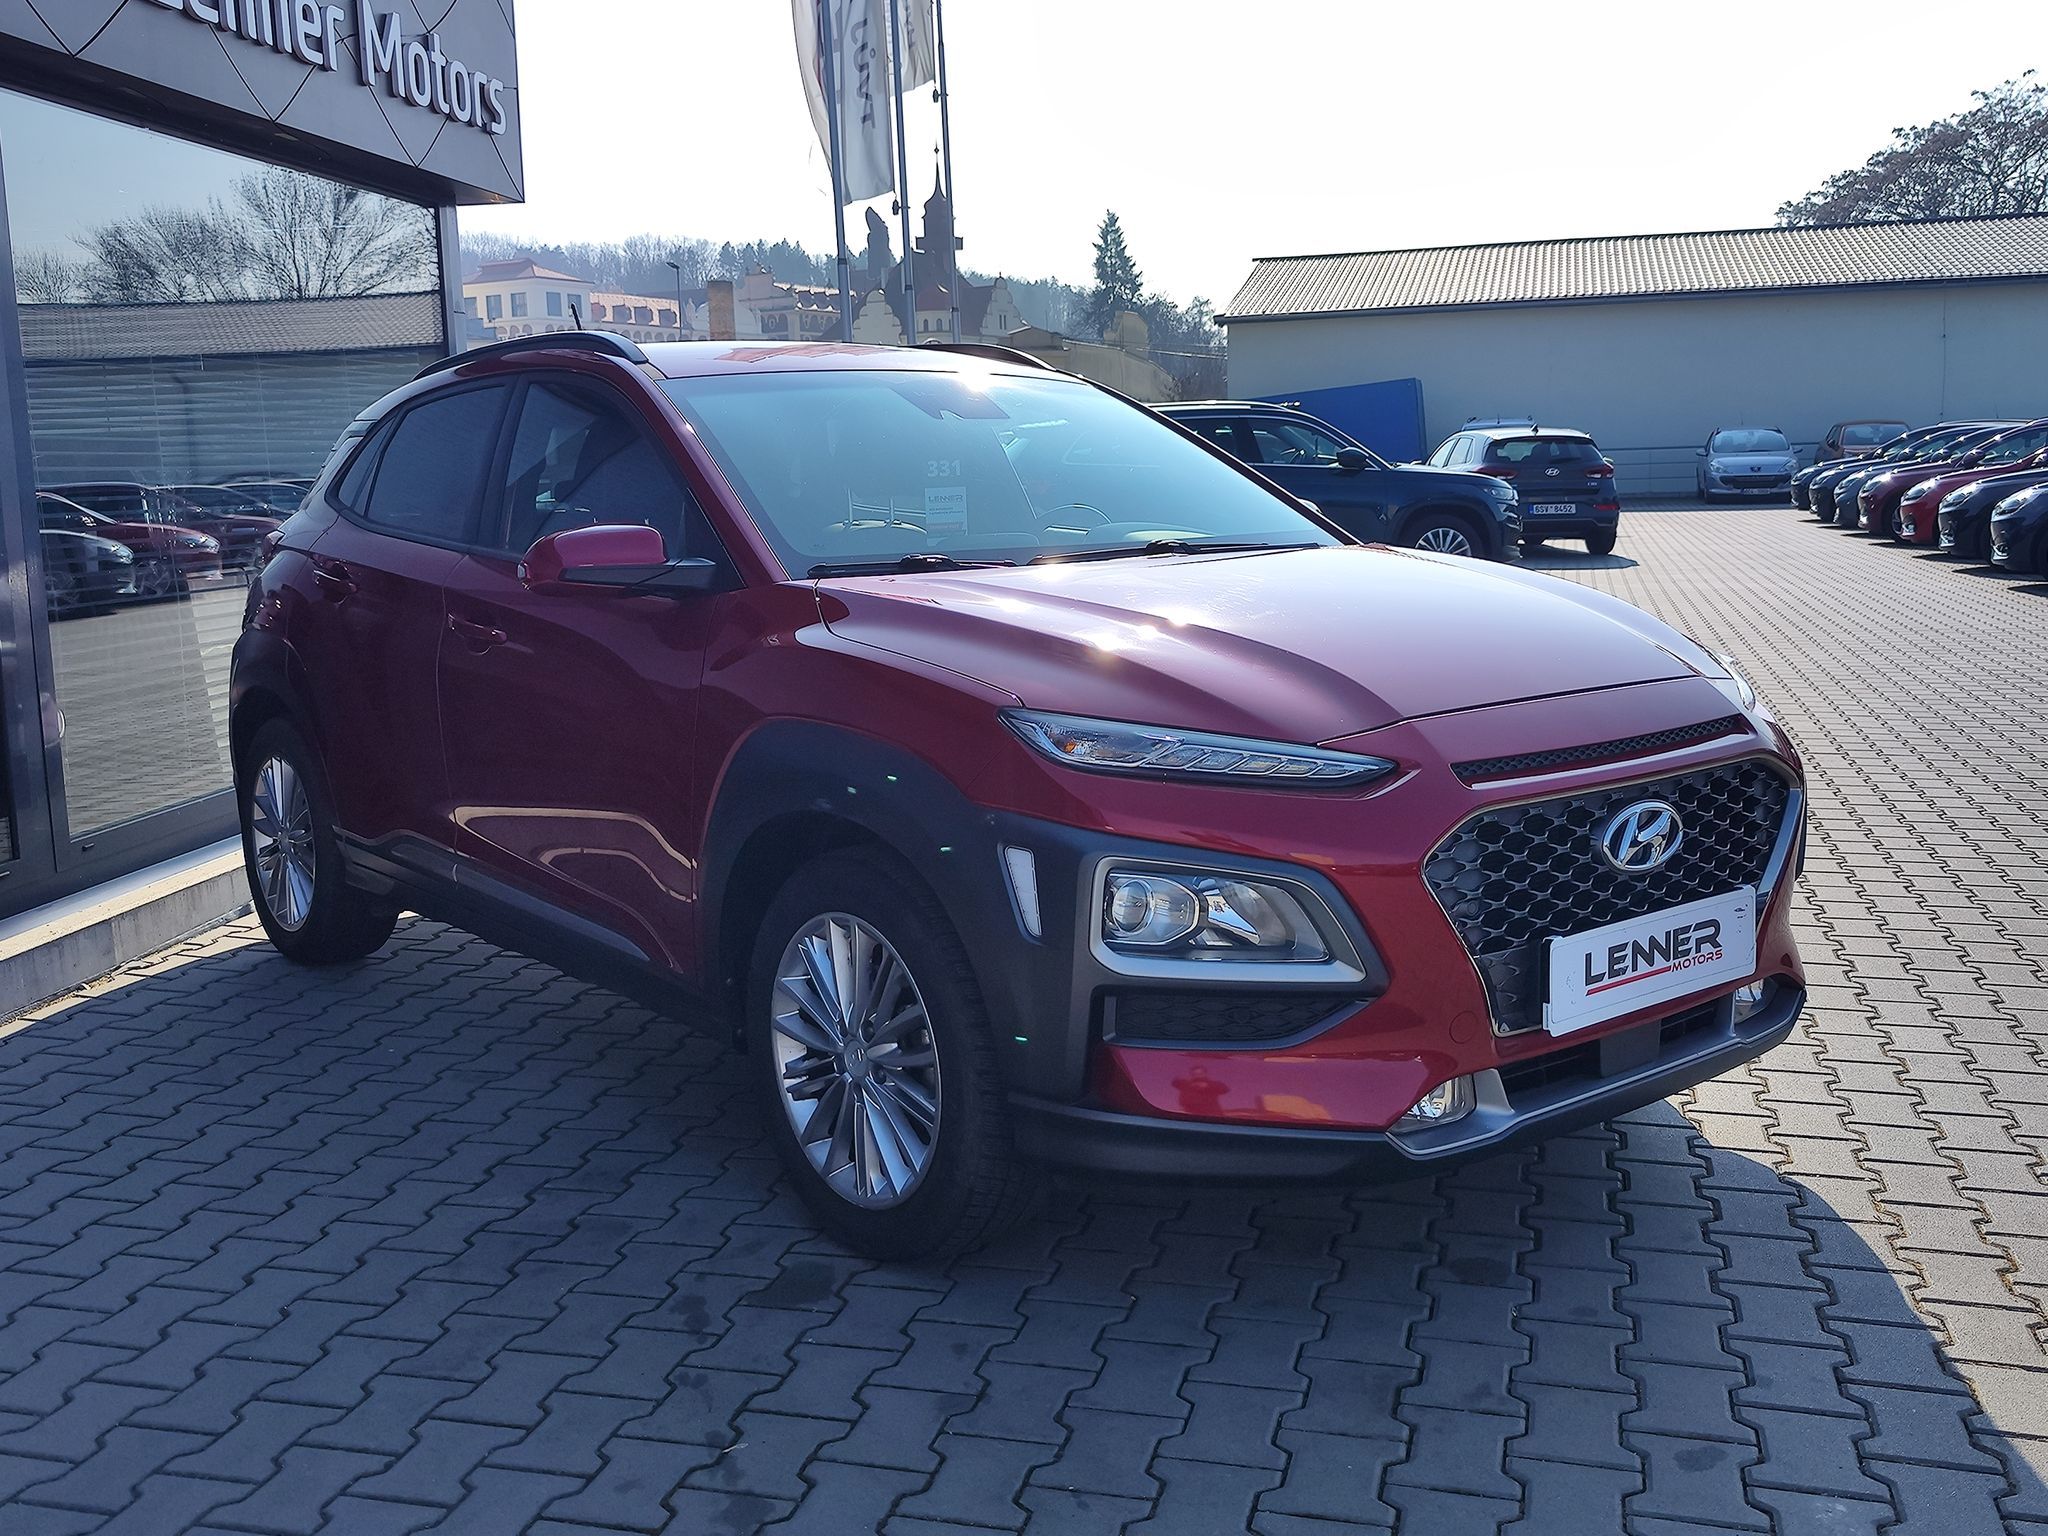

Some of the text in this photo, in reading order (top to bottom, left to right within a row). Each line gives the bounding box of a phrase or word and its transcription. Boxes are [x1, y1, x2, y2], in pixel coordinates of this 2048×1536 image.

[358, 0, 507, 136] Motors
[1585, 918, 1722, 986] LENNER
[1671, 949, 1723, 973] MOTORS
